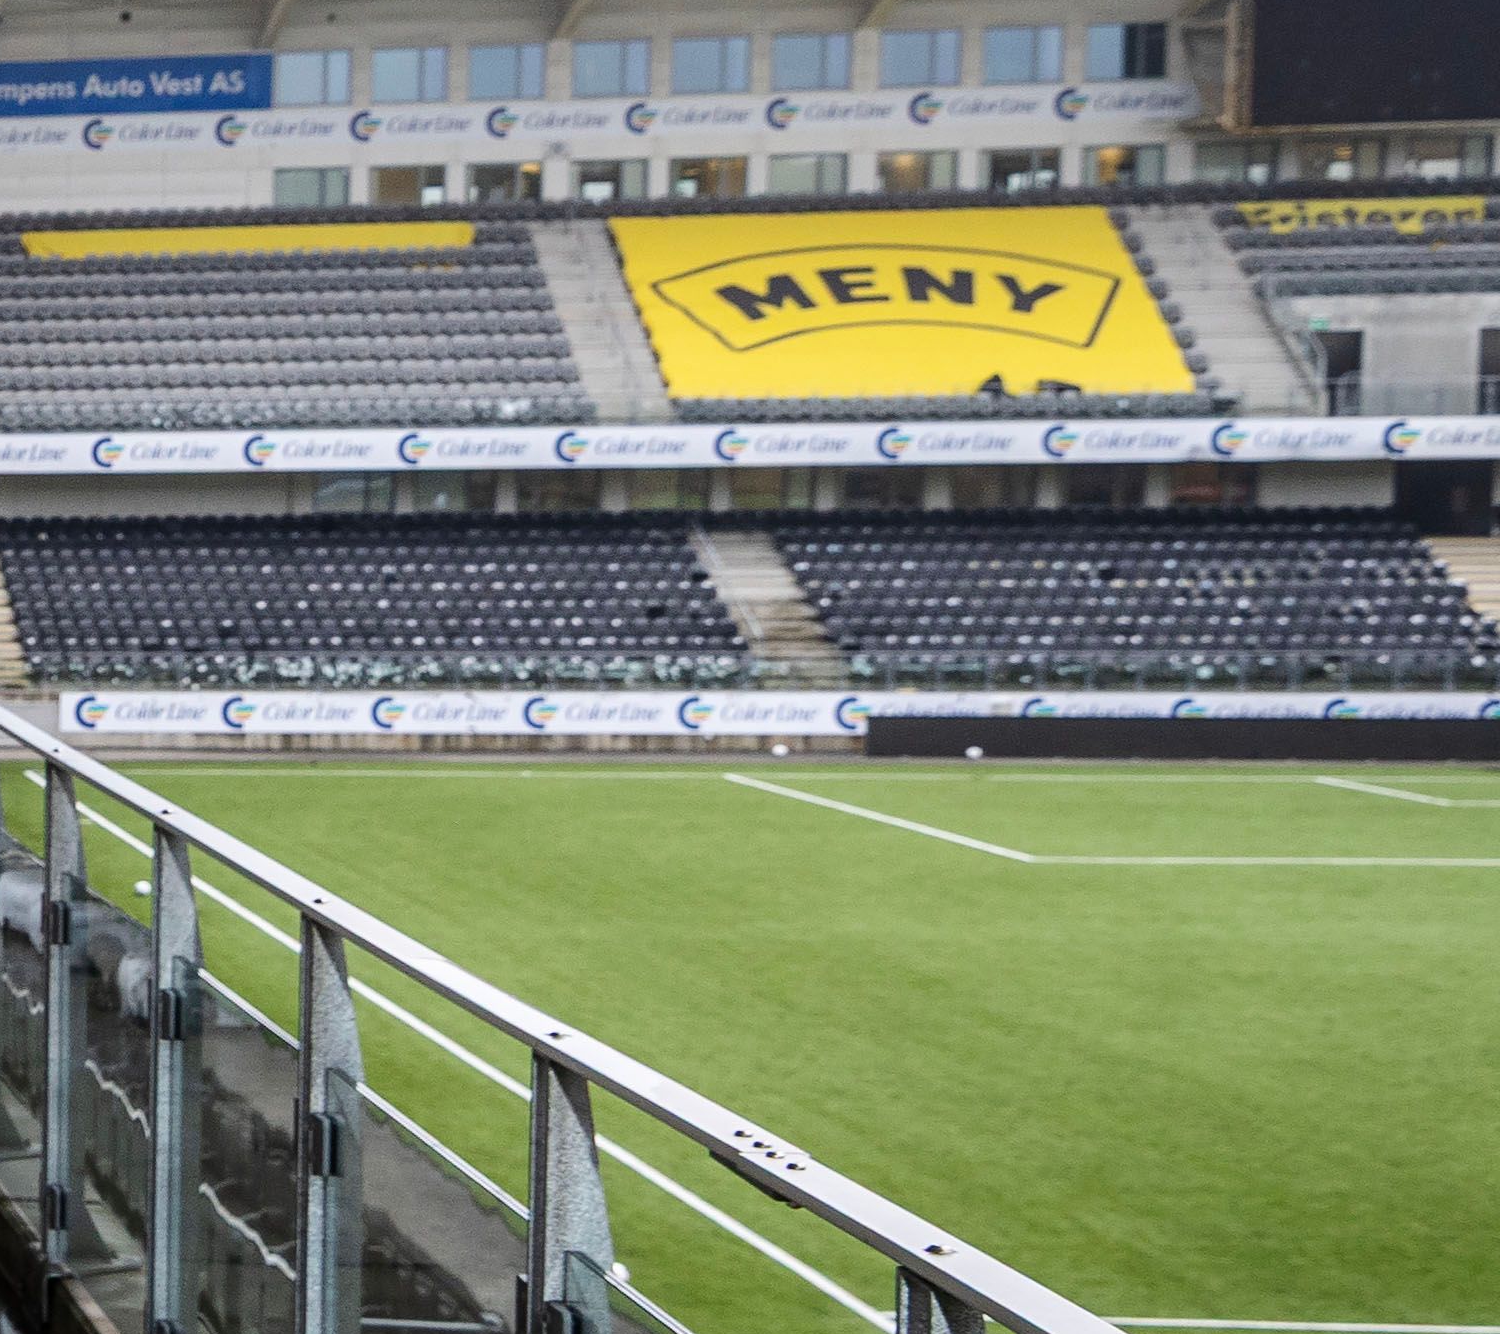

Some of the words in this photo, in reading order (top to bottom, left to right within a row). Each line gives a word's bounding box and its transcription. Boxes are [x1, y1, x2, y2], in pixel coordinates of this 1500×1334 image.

[82, 73, 145, 99] Auto
[149, 71, 202, 95] Vest
[208, 70, 245, 94] AS
[714, 265, 1064, 322] MENY
[754, 435, 804, 453] Color
[917, 434, 967, 452] Color
[1083, 432, 1134, 450] Color
[1253, 427, 1305, 447] Color
[1426, 427, 1479, 445] Color
[130, 442, 176, 461] Color
[282, 441, 330, 459] Color
[436, 439, 486, 458] Color
[594, 437, 642, 456] Color
[114, 704, 164, 721] Color
[261, 704, 312, 721] Color
[412, 704, 463, 722] Color
[565, 704, 616, 722] Color
[719, 704, 772, 722] Color
